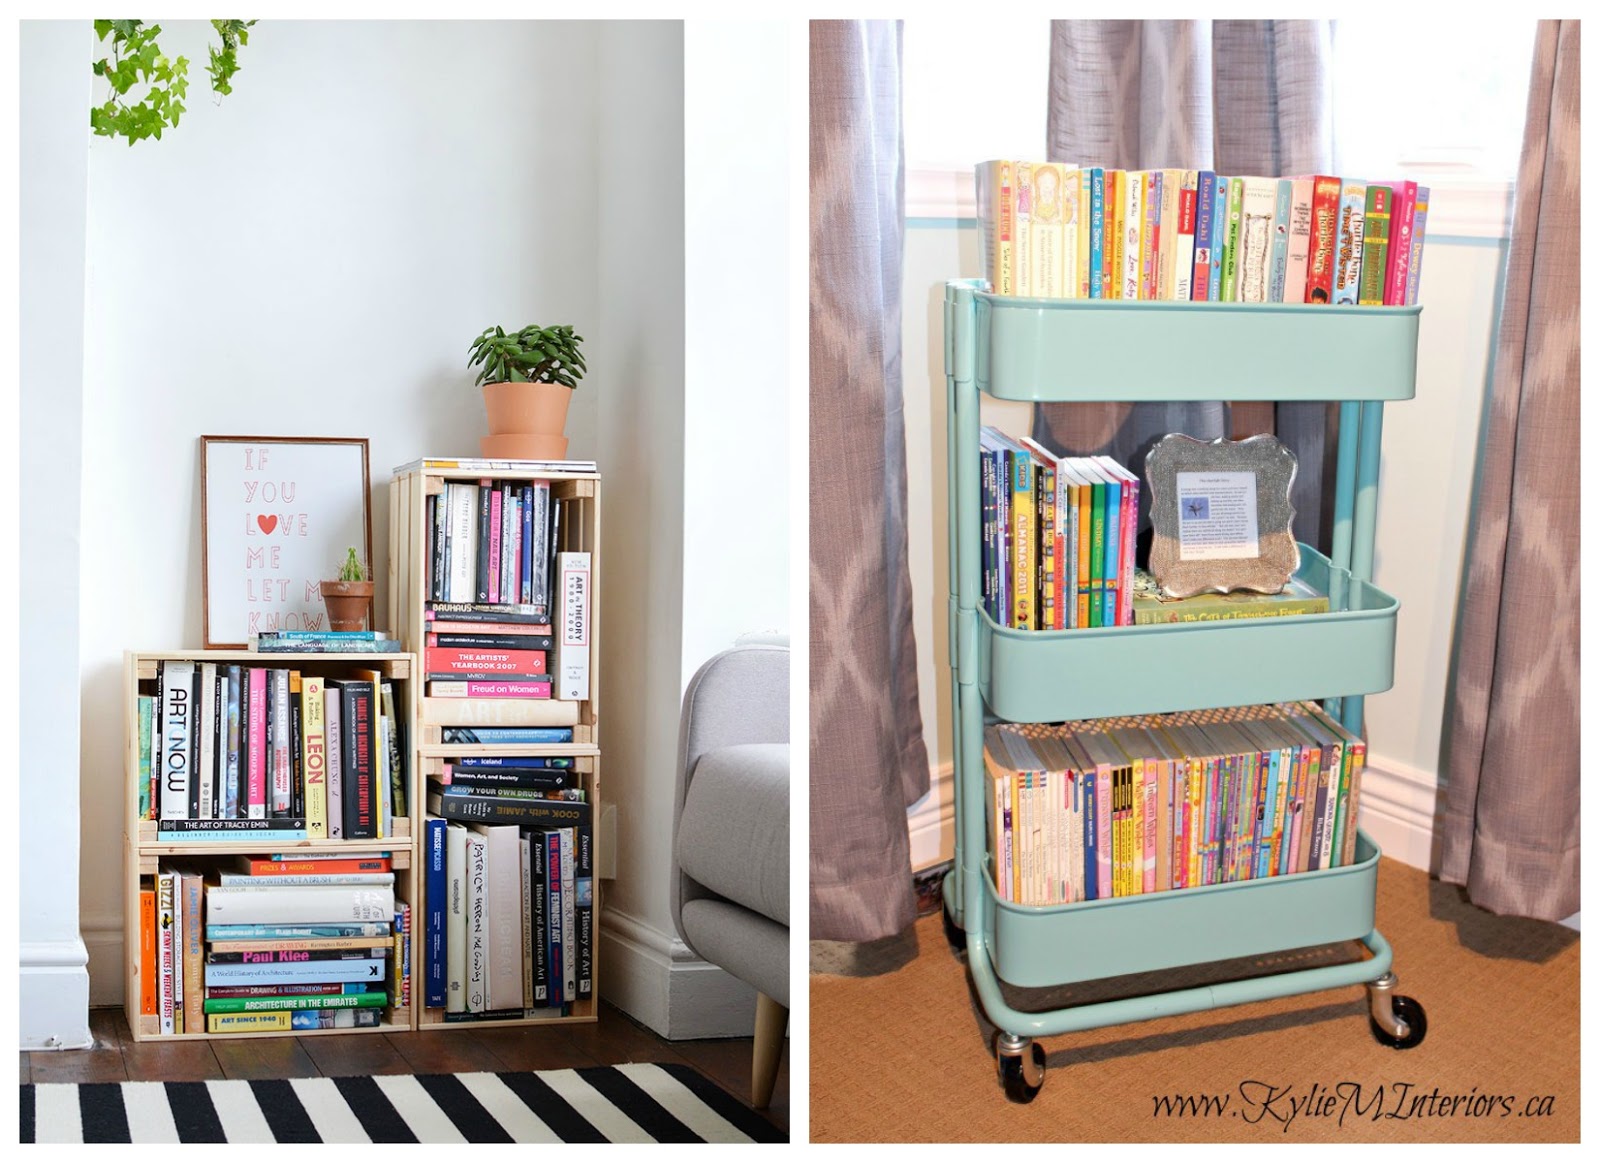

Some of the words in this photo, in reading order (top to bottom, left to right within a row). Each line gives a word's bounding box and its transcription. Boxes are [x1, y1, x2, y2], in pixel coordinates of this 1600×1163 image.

[1094, 177, 1102, 196] Lost
[1203, 177, 1212, 210] Roald
[1095, 198, 1102, 207] in
[1094, 211, 1102, 225] the
[1200, 214, 1211, 242] Dahl
[1317, 208, 1330, 247] Charlie
[1342, 206, 1352, 236] TIME
[1093, 228, 1102, 251] Snow
[1351, 212, 1366, 253] Charlie
[1313, 247, 1329, 274] Bone
[1336, 237, 1351, 291] TWISTER
[1346, 254, 1361, 285] Bone
[1409, 243, 1421, 275] Dewey
[1126, 277, 1138, 298] Ruby
[1197, 276, 1206, 298] THE
[245, 448, 269, 471] IF
[1018, 464, 1027, 488] KIDS
[244, 482, 296, 504] YOU
[1017, 514, 1028, 570] ALMANAC
[246, 546, 280, 569] ME
[247, 578, 290, 602] LET
[575, 576, 583, 595] ART
[1018, 571, 1028, 595] 2011
[432, 603, 472, 612] BAUHAUS
[248, 612, 324, 635] KNOW
[575, 604, 583, 642] THEORY
[451, 662, 496, 670] YEARBOOK
[496, 662, 518, 670] 2007
[458, 653, 474, 661] THE
[250, 689, 259, 704] THE
[277, 675, 287, 705] JULIAN
[472, 685, 496, 693] Freud
[497, 685, 507, 693] on
[509, 685, 539, 693] Women
[169, 688, 188, 730] ART
[250, 705, 259, 729] STORY
[458, 702, 506, 723] ART
[277, 705, 286, 743] ASSANGE
[250, 731, 258, 743] OF
[329, 721, 338, 752] ALEXA
[167, 737, 187, 792] NOW
[250, 745, 259, 780] MODERN
[306, 734, 323, 784] LEON
[330, 753, 339, 786] CHUNG
[480, 757, 503, 765] Iceland
[454, 772, 477, 780] Women,
[499, 774, 519, 782] Society
[250, 781, 258, 799] ART
[516, 790, 543, 798] DRUGS
[1146, 781, 1157, 818] Unicorn
[359, 815, 370, 827] ART
[497, 805, 527, 815] JAMIE
[529, 808, 550, 816] with
[551, 809, 580, 819] COOK
[184, 822, 201, 830] THE
[224, 821, 250, 829] TRACEY
[250, 820, 269, 828] EMIN
[1145, 818, 1156, 848] Wishes
[1315, 817, 1323, 835] Black
[550, 836, 559, 851] THE
[581, 834, 590, 870] Essential
[1312, 835, 1321, 858] Beauty
[288, 863, 315, 871] AWARDS
[473, 843, 485, 894] PATRICK
[535, 843, 543, 875] Essential
[550, 852, 560, 881] POWER
[229, 878, 266, 886] PAINTING
[266, 877, 302, 885] WITHOUT
[551, 881, 560, 892] OF
[160, 878, 173, 911] GIZZI
[189, 886, 199, 916] JAMIE
[536, 884, 545, 915] History
[474, 897, 482, 933] HERON
[537, 915, 545, 926] of
[551, 892, 561, 928] FEMINIST
[562, 878, 574, 942] DECORATING
[189, 917, 199, 955] OLIVER
[551, 928, 561, 944] ART
[581, 910, 590, 946] History
[243, 951, 274, 963] Paul
[278, 950, 310, 961] Klee
[537, 926, 545, 966] American
[582, 947, 591, 959] of
[163, 950, 172, 968] WEEKS
[566, 944, 574, 972] BOOK
[581, 960, 591, 976] Art
[188, 957, 199, 992] jamie's
[234, 970, 255, 978] History
[537, 966, 545, 981] Art
[163, 973, 172, 999] WEEKEND
[250, 986, 277, 995] DRAWING
[284, 985, 323, 993] ILLUSTRATION
[163, 998, 172, 1019] FEASTS
[191, 994, 201, 1016] italy
[244, 1000, 298, 1010] ARCHITECTURE
[298, 999, 306, 1007] IN
[307, 998, 322, 1007] THE
[323, 996, 359, 1006] EMIRATES
[259, 1014, 276, 1022] 1940
